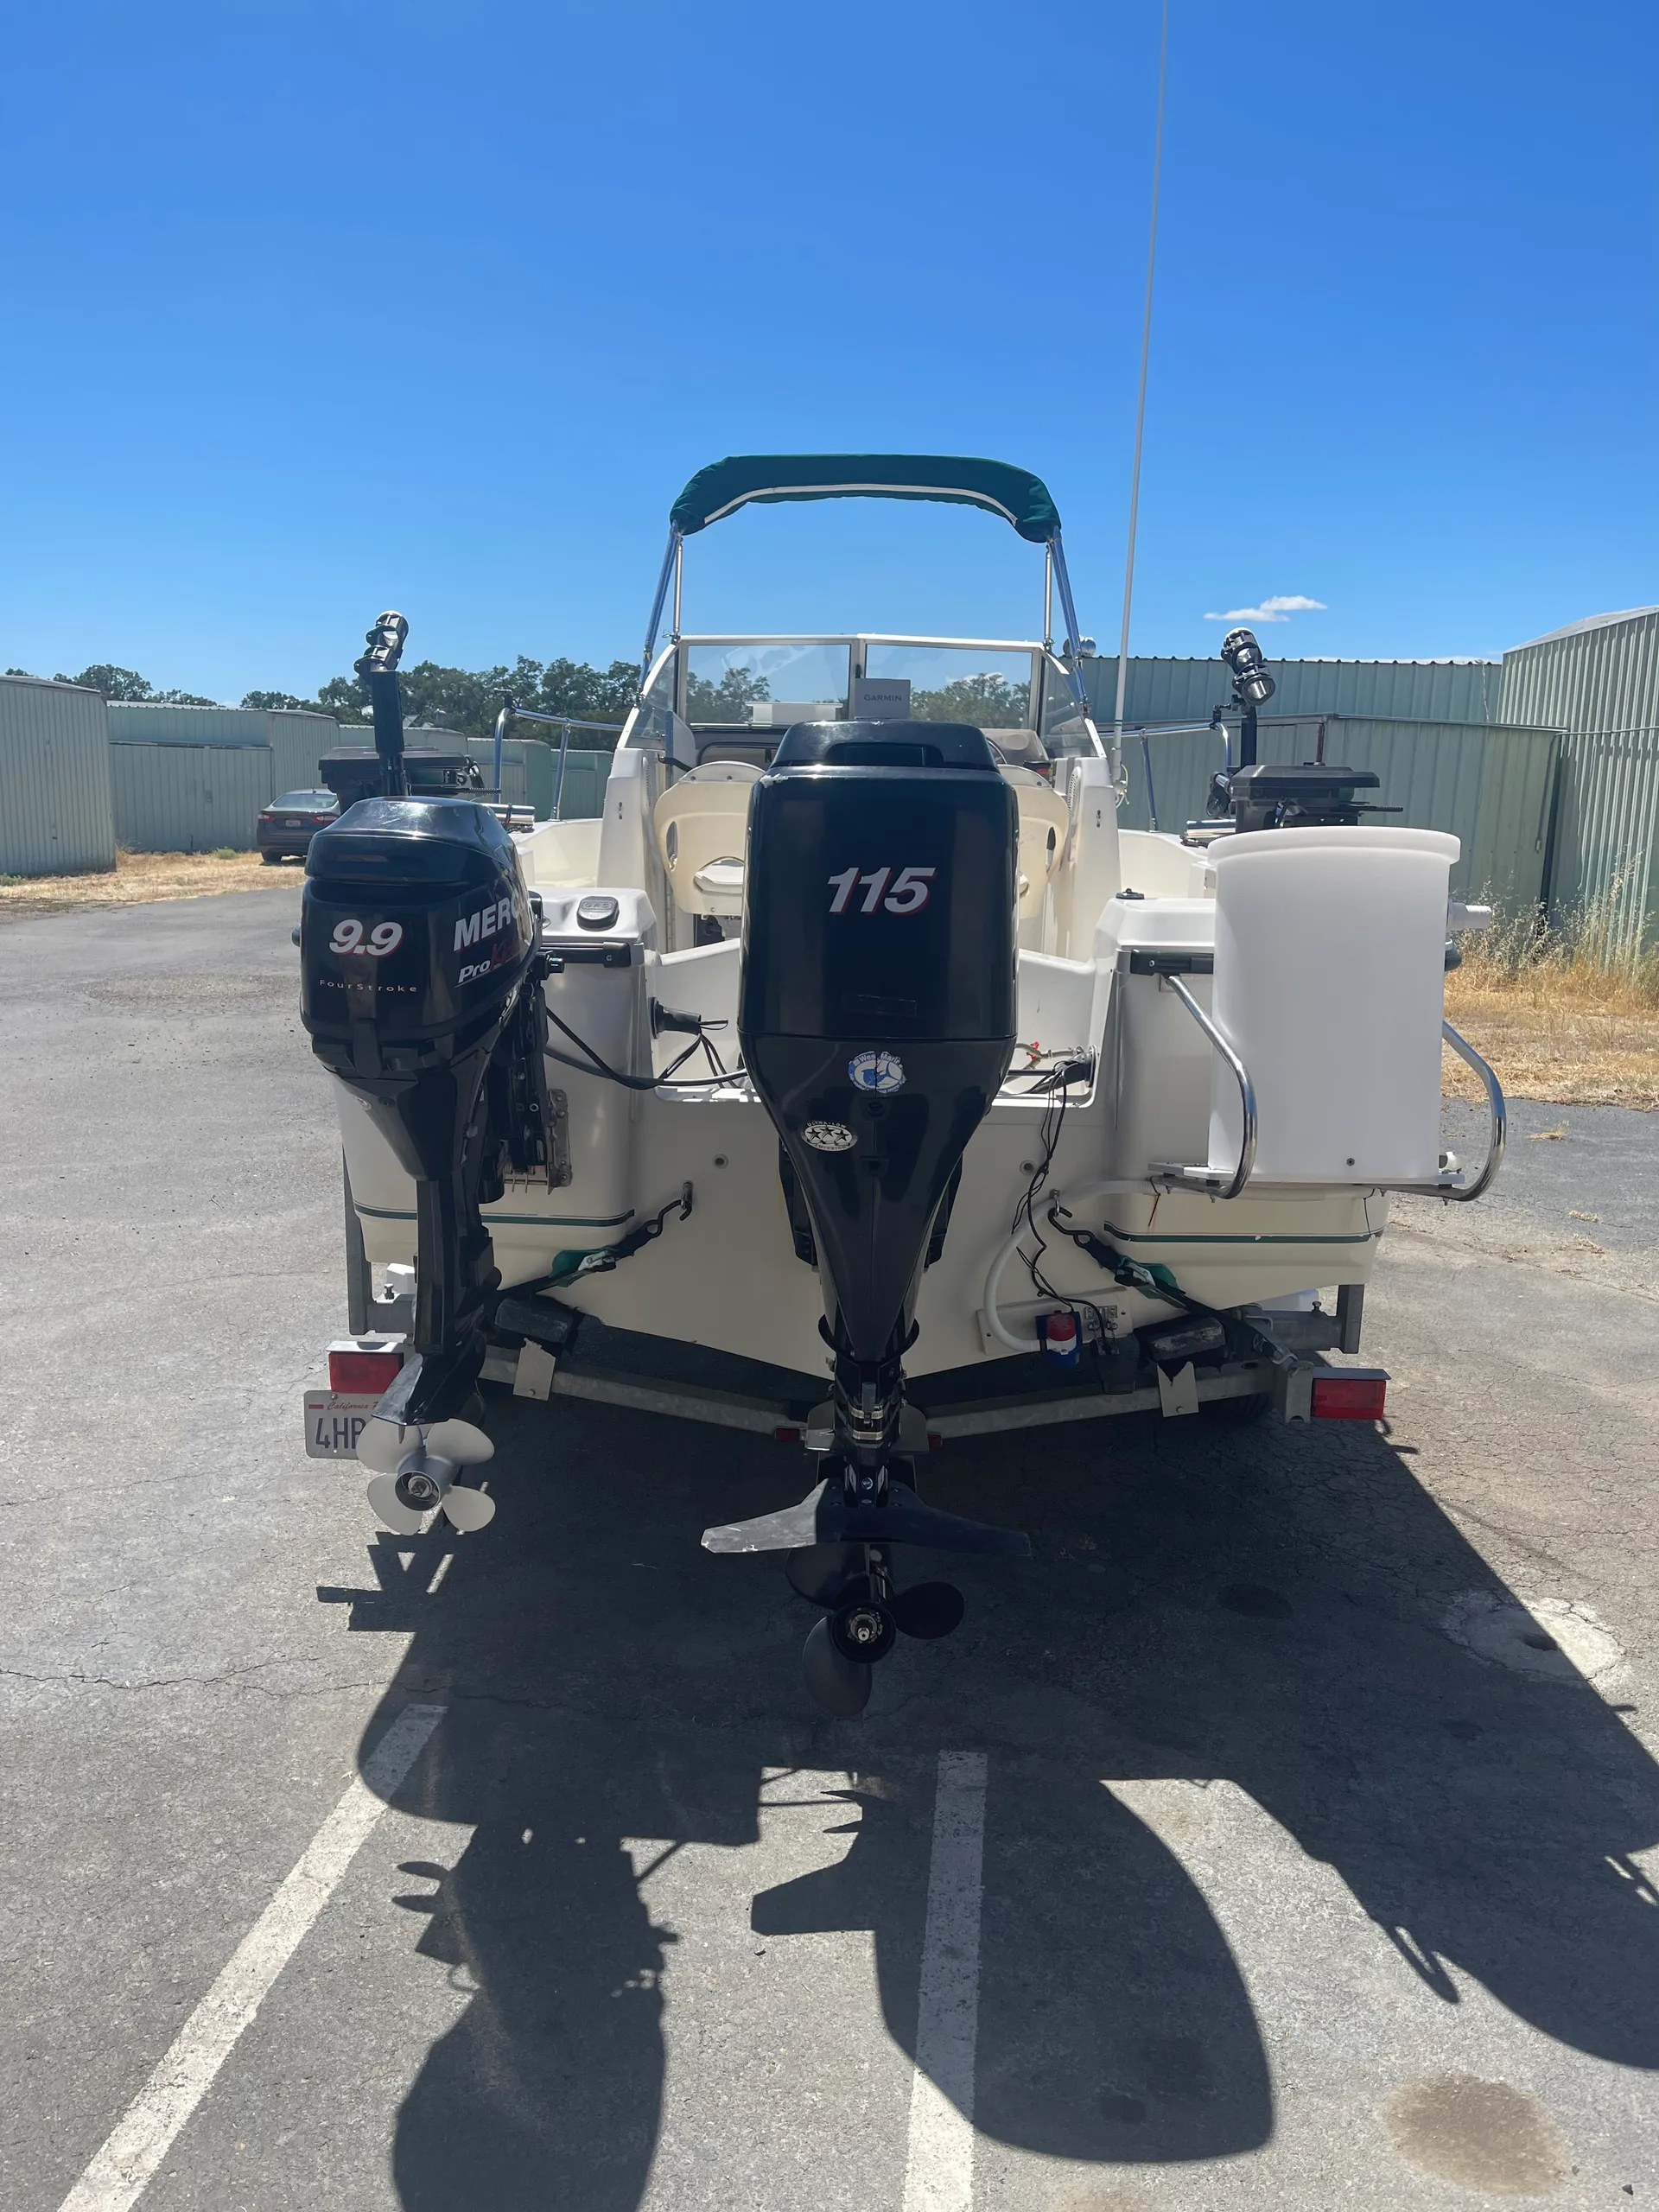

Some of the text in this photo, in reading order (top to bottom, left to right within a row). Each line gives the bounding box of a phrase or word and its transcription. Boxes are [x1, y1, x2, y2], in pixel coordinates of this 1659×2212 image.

[827, 867, 937, 914] 115
[329, 918, 404, 957] 9.9
[319, 979, 417, 993] FourStroke
[327, 1400, 370, 1411] California
